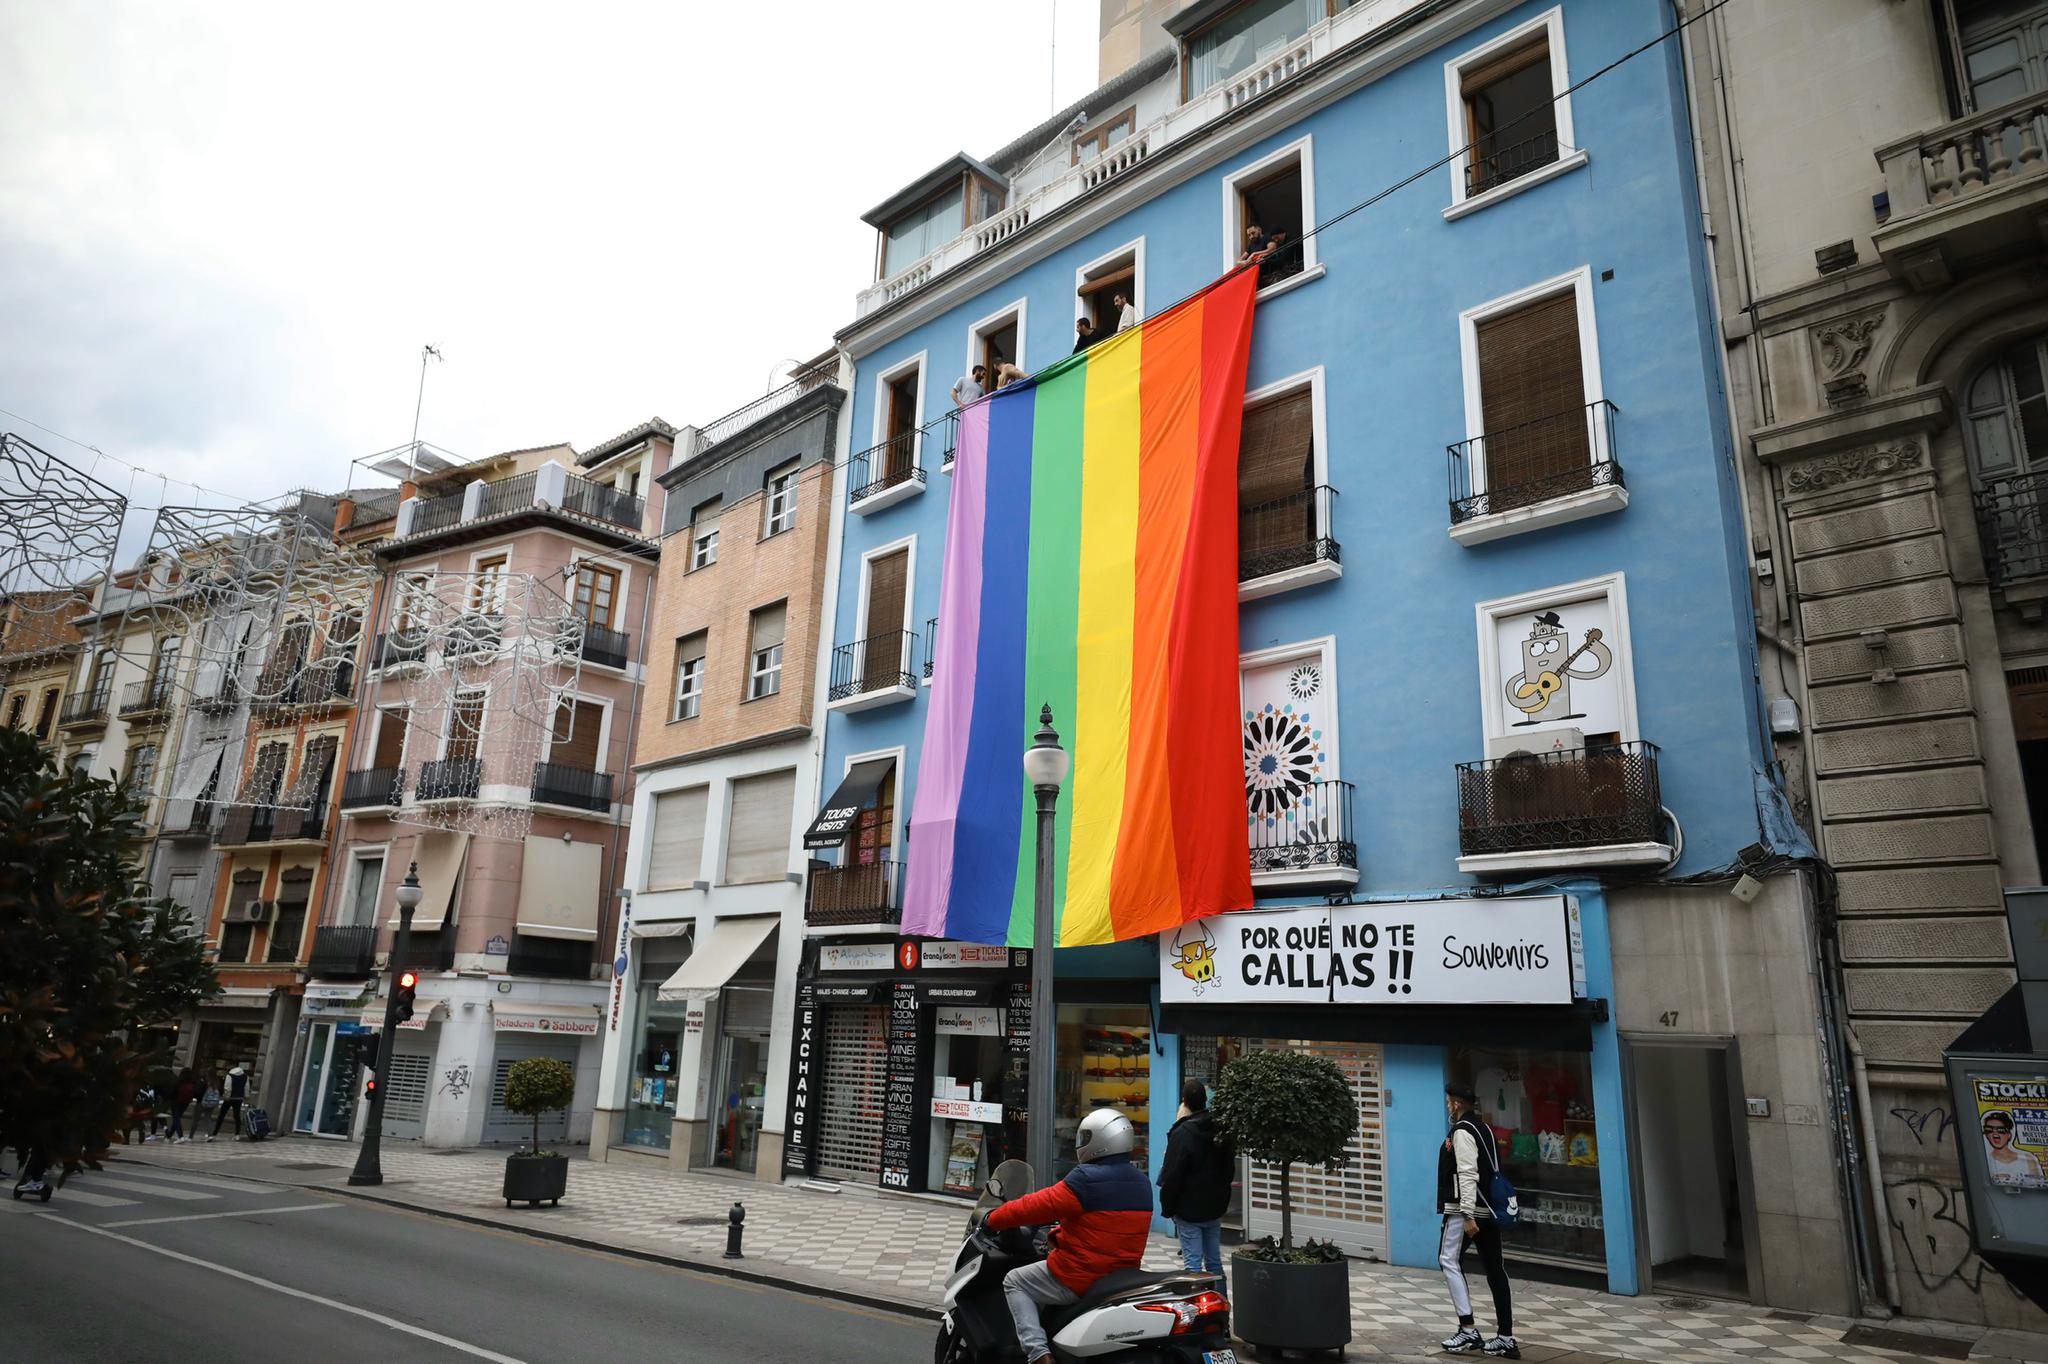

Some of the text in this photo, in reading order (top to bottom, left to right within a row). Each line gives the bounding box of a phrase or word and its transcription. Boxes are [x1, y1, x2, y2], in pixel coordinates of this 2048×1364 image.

[824, 806, 858, 820] TOURS
[815, 820, 847, 832] VISITS
[1241, 918, 1415, 951] POR QUÉ NO TE
[982, 946, 1007, 955] TICKETS
[1443, 935, 1550, 971] Souvenirs
[1241, 950, 1415, 995] CALLAS !!
[551, 1020, 596, 1033] Sabbore
[1659, 1011, 1680, 1027] 47
[792, 1011, 813, 1144] EXCHANGE
[950, 1102, 970, 1111] TICKETS
